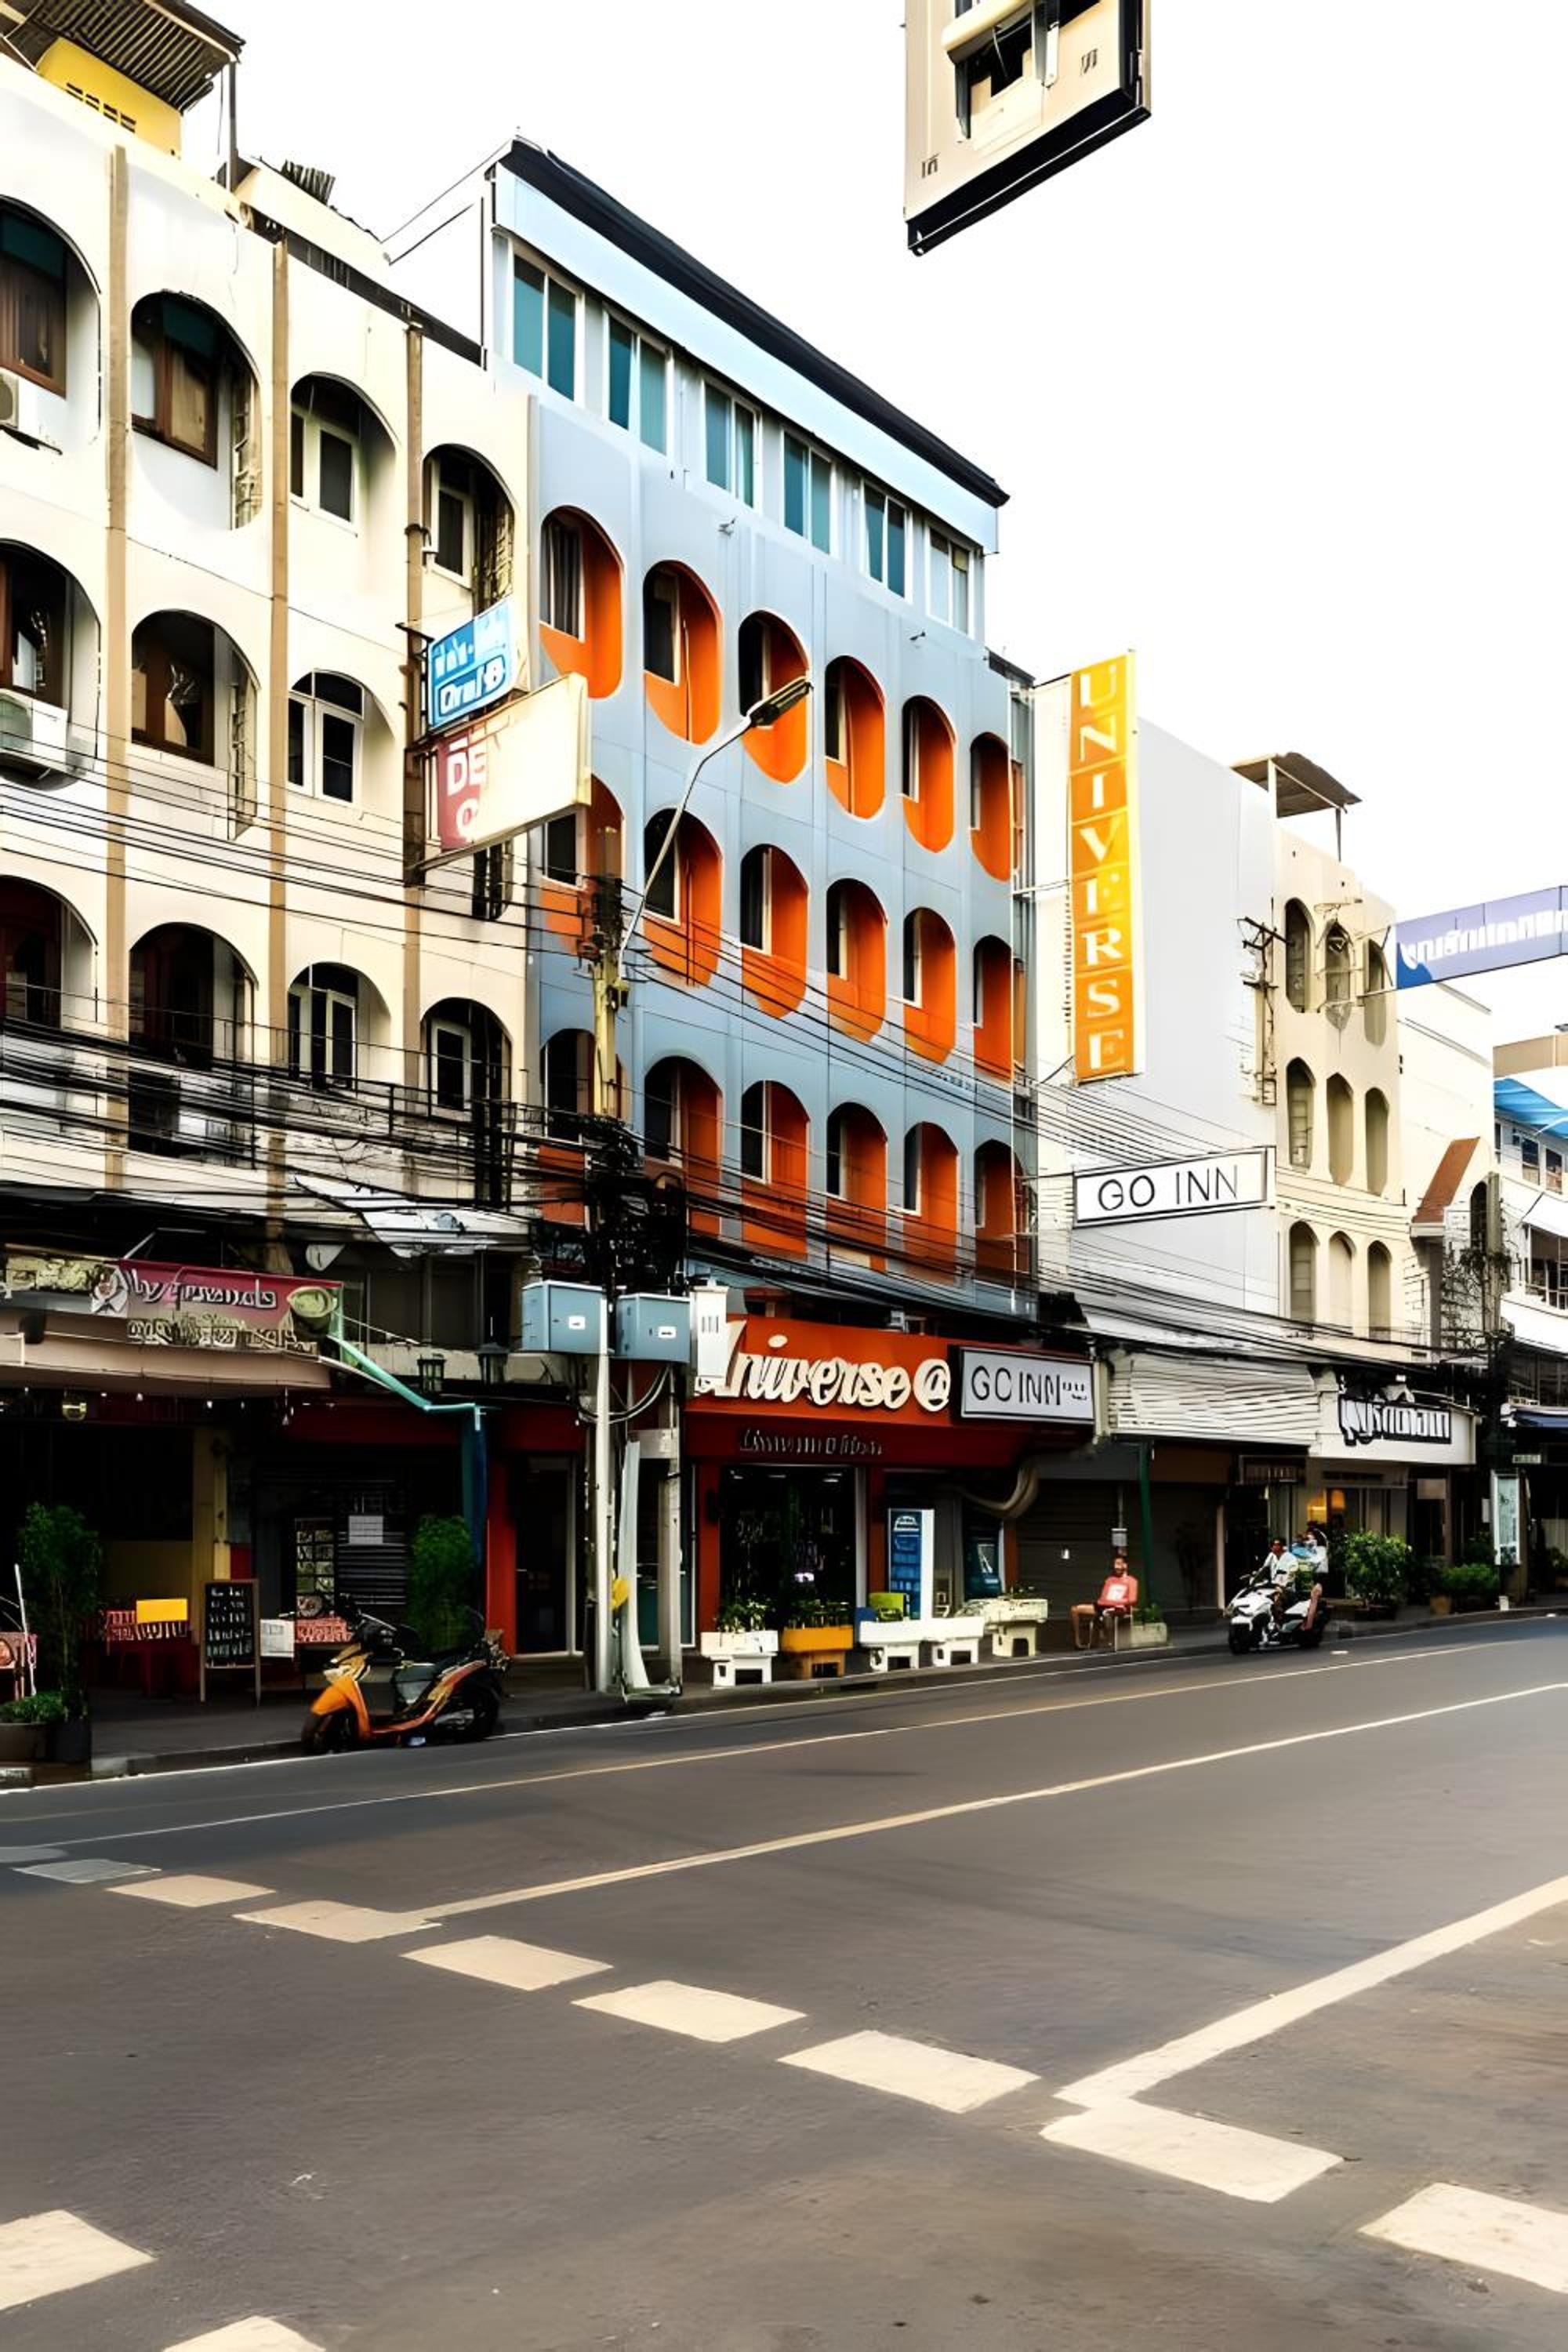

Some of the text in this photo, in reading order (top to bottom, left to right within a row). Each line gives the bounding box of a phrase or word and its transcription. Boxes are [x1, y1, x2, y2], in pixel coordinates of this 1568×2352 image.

[1098, 1164, 1238, 1211] GO INN
[1018, 1370, 1062, 1406] INN
